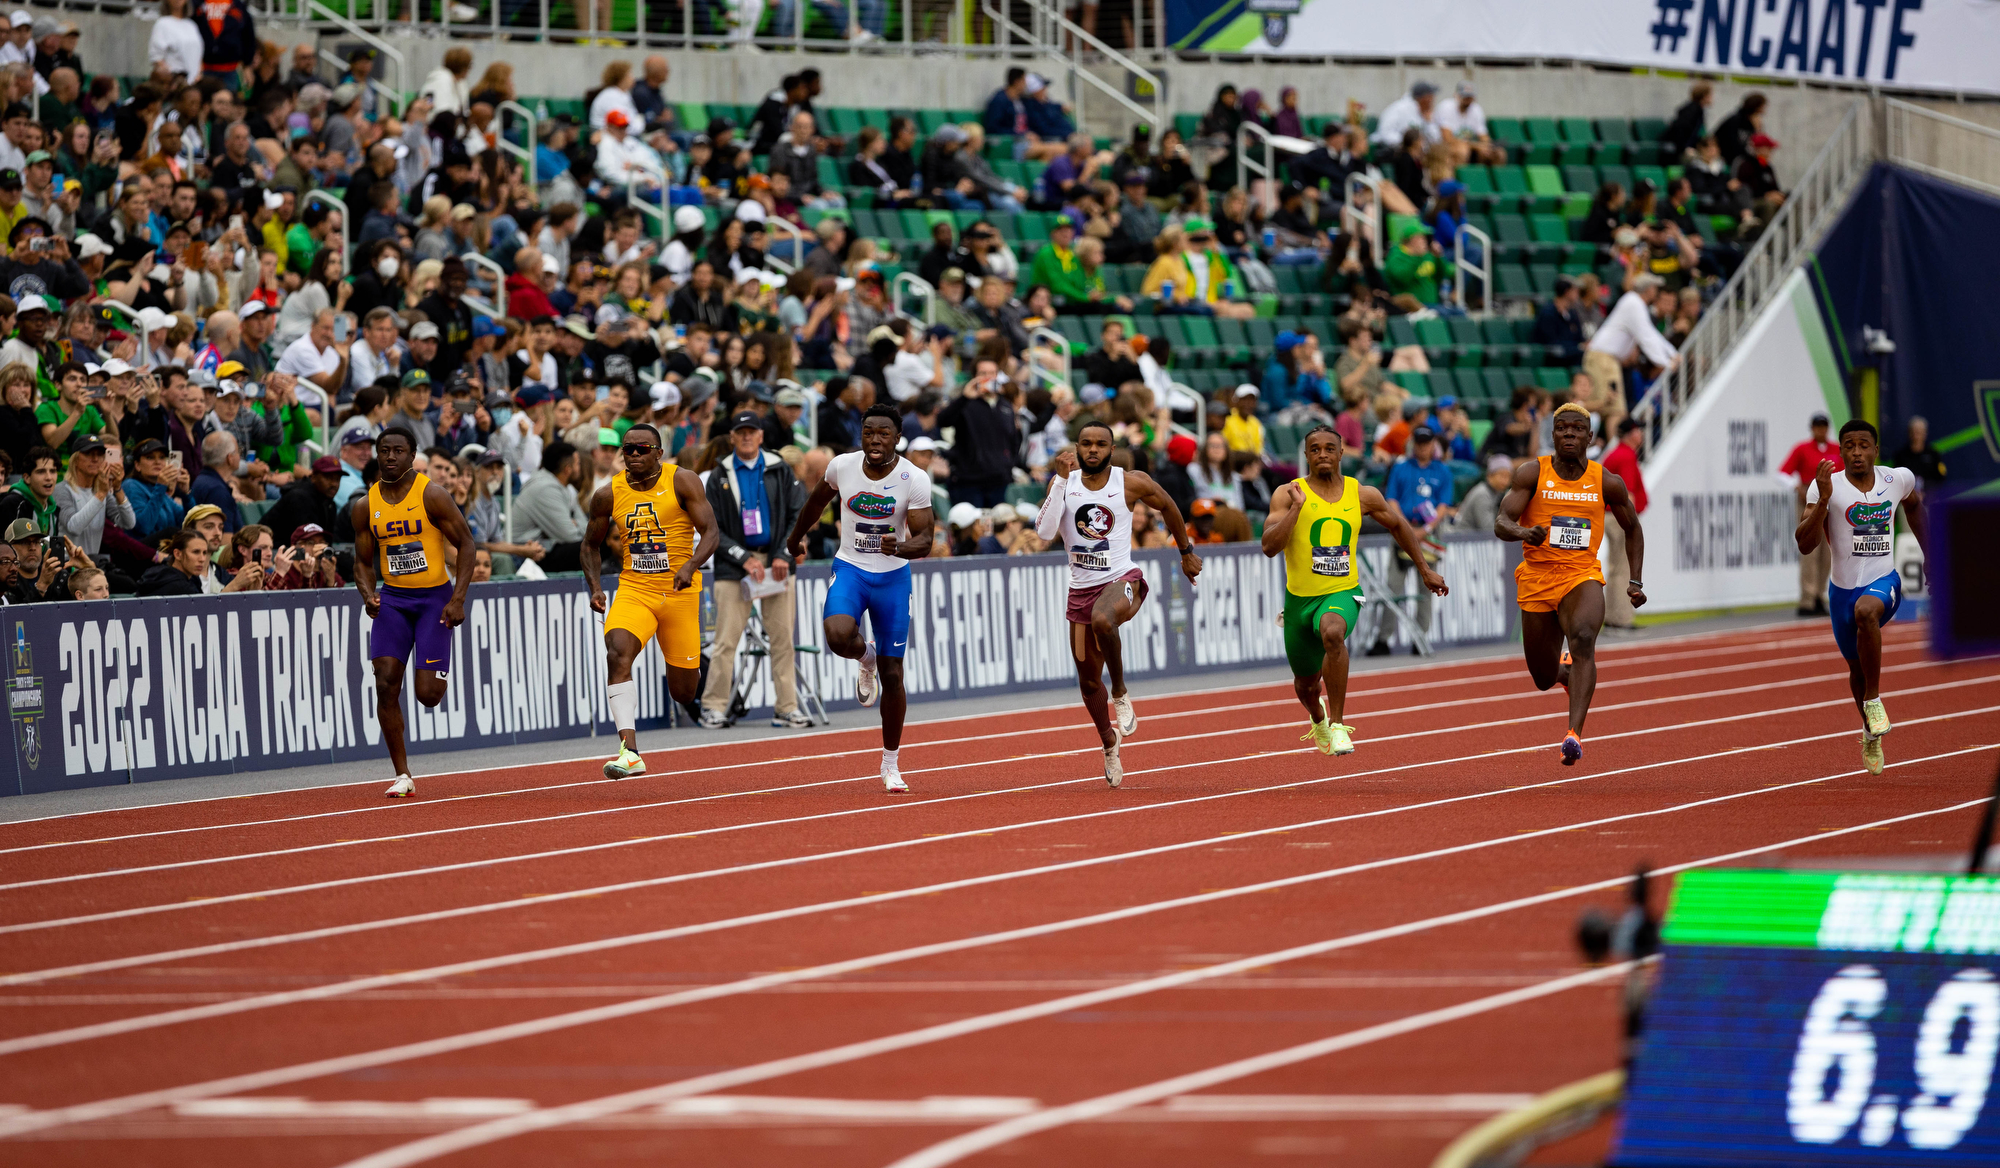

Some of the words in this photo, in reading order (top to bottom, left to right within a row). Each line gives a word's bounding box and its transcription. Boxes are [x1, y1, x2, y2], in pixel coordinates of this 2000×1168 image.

[1650, 0, 1922, 80] #NCAATF
[1541, 490, 1599, 502] TENNESSEE
[373, 519, 422, 540] LSU
[1560, 527, 1582, 535] FAVOUR
[1558, 534, 1582, 545] ASHE
[1853, 541, 1890, 551] VANOVER
[389, 557, 425, 570] FLEMING
[632, 559, 668, 569] HARDING
[1076, 553, 1107, 566] MARTIN
[1312, 561, 1350, 571] WILLIAMS
[930, 572, 950, 691] &
[951, 568, 1009, 689] FIELD
[59, 618, 156, 776] 2022
[160, 611, 249, 766] NCAA
[251, 605, 356, 755] TRACK
[1786, 965, 2000, 1150] 6.9
